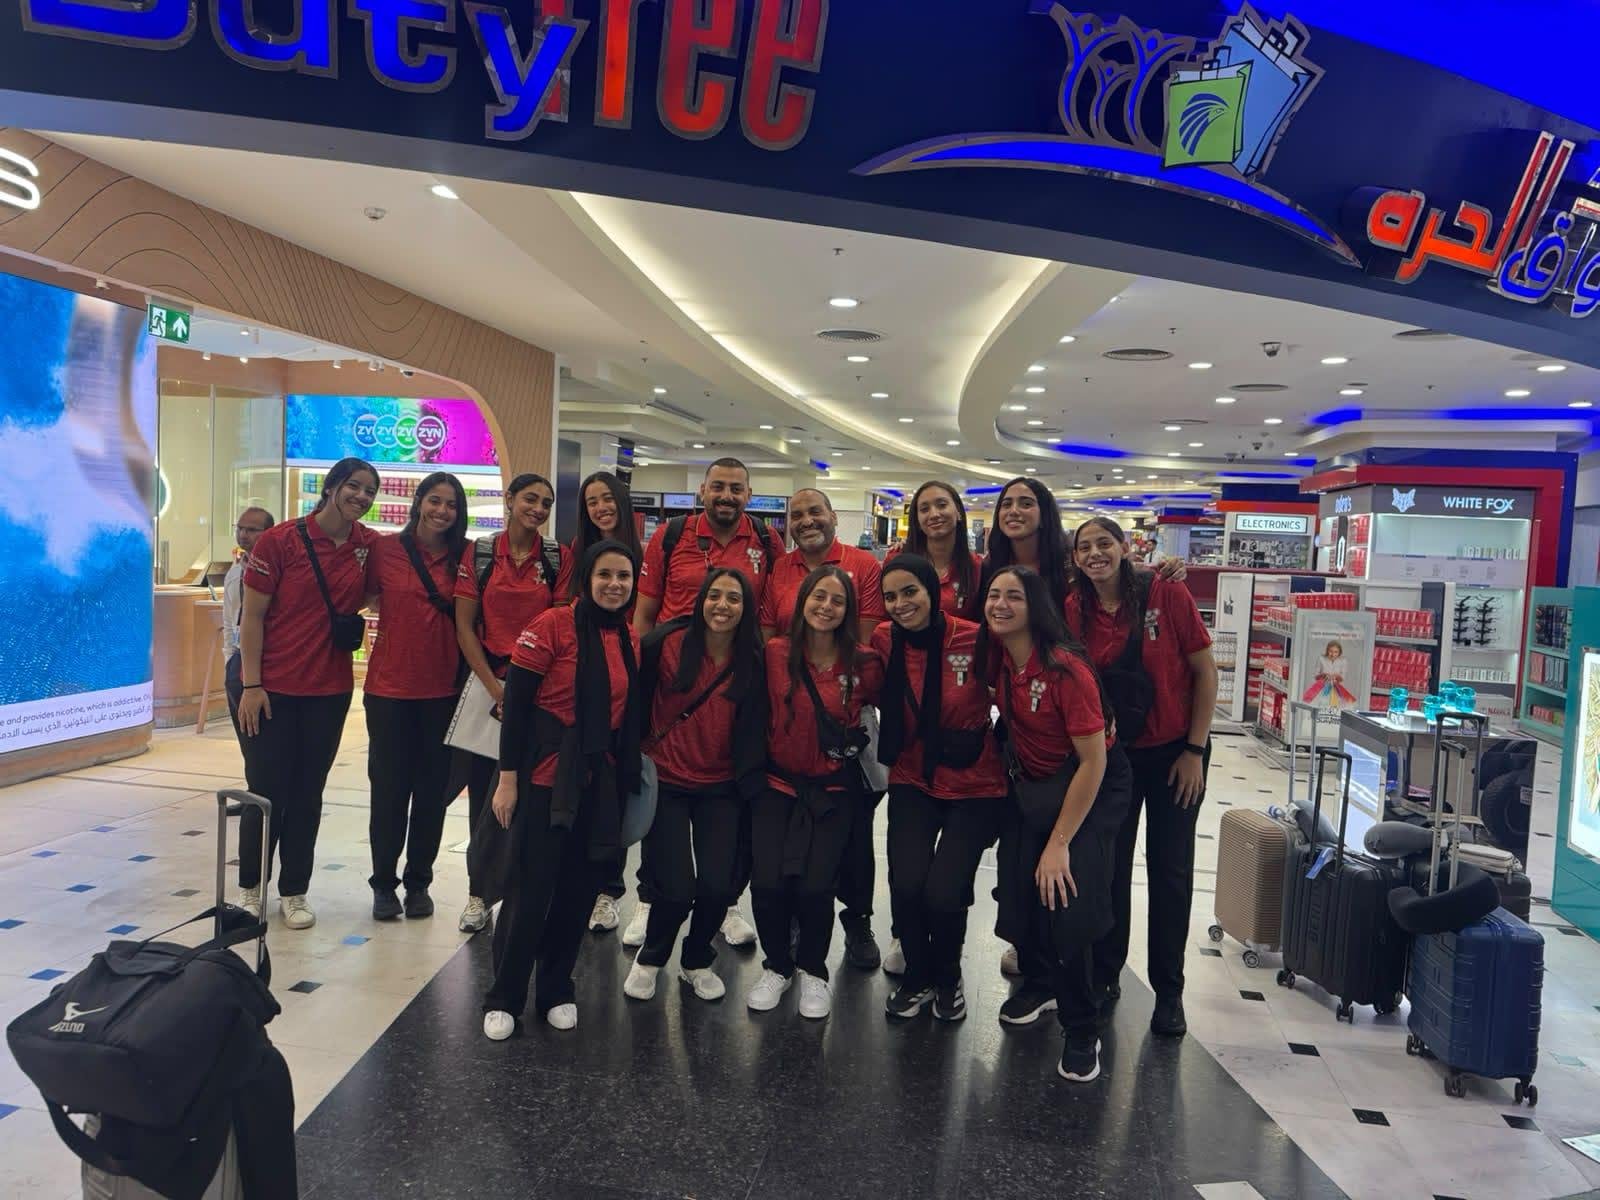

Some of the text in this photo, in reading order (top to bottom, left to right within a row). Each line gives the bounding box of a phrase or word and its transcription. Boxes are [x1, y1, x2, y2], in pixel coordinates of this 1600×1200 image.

[418, 427, 442, 438] ZYN
[1442, 495, 1515, 514] WHITE FOX
[1242, 518, 1301, 530] ELECTRONICS
[7, 715, 21, 726] and
[23, 711, 54, 724] provides
[86, 701, 106, 711] which
